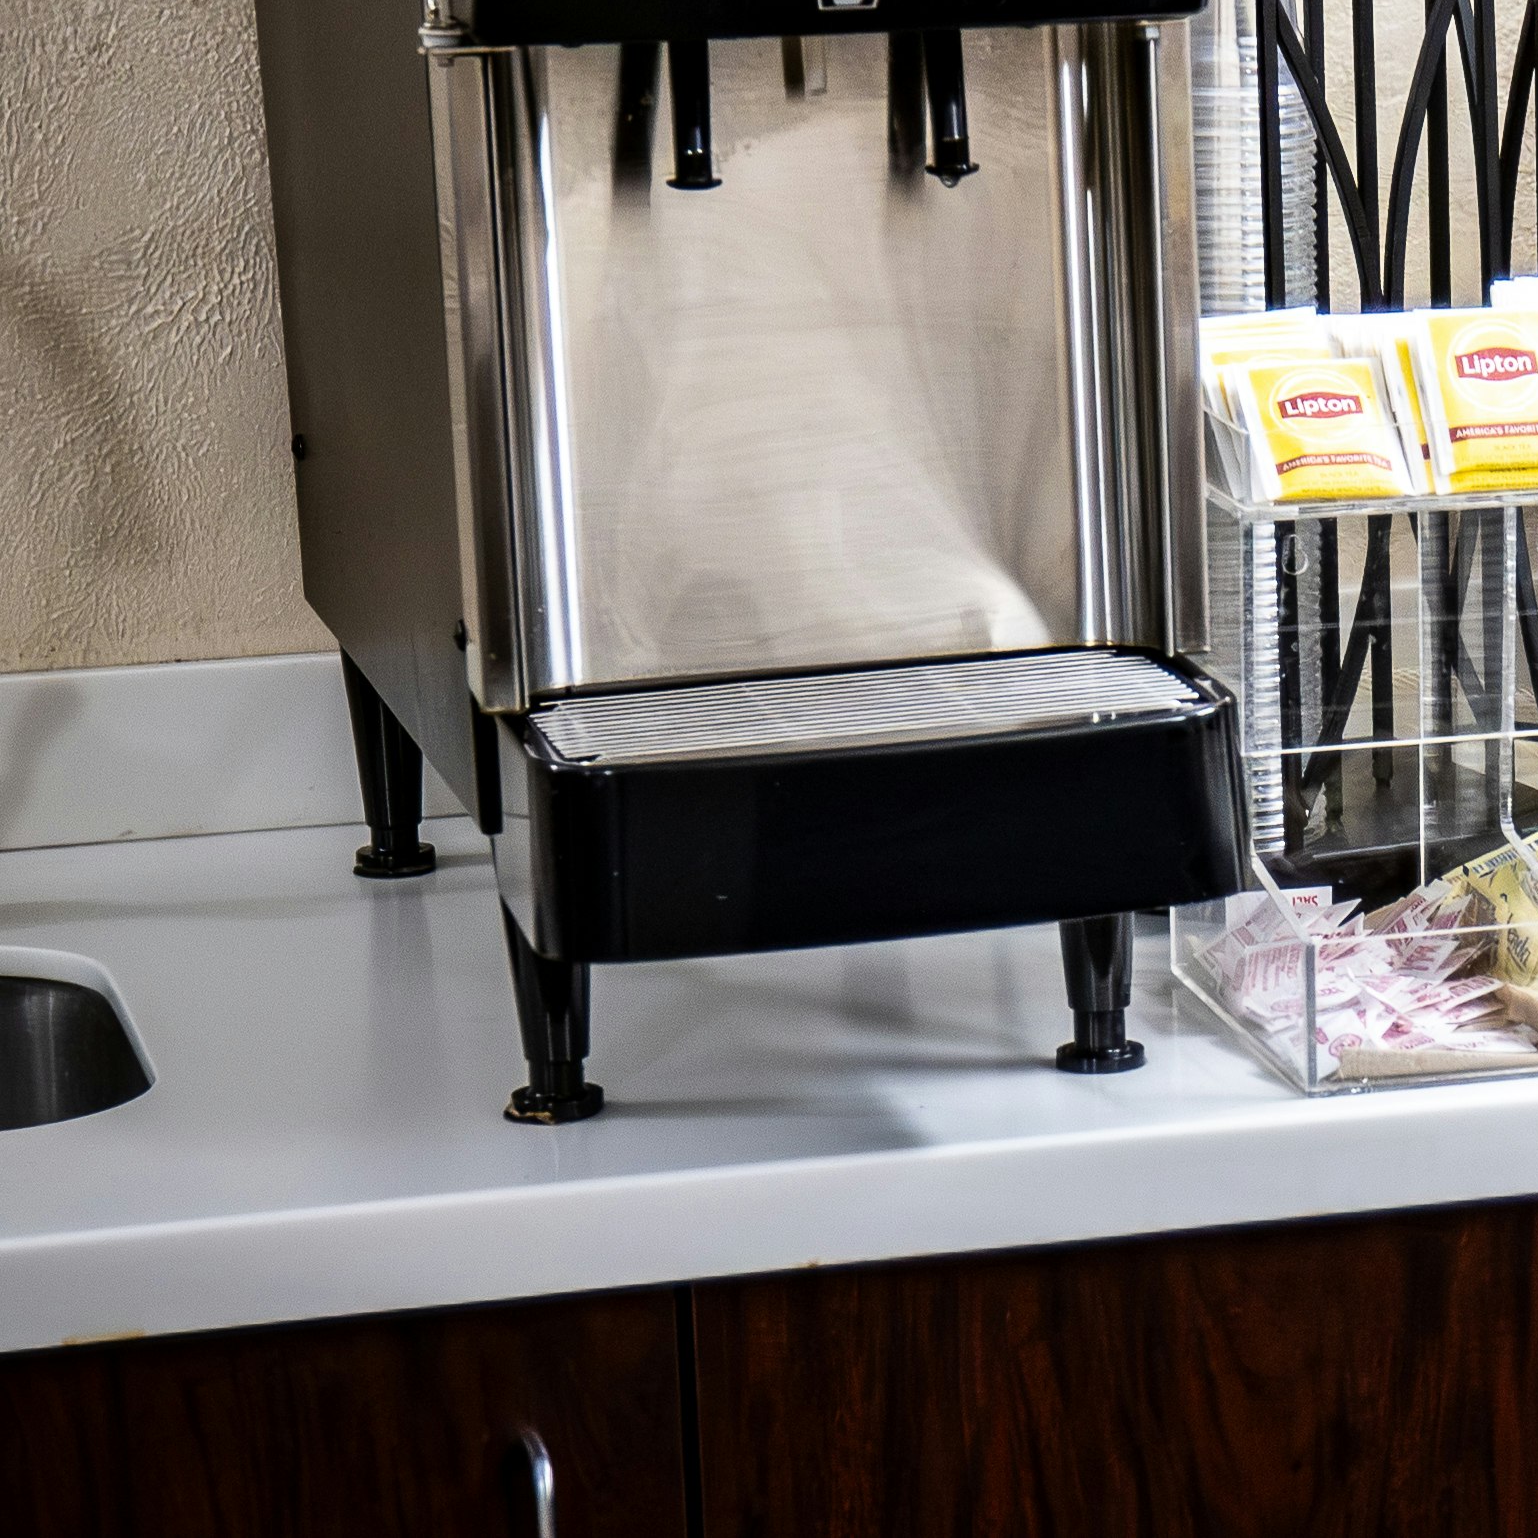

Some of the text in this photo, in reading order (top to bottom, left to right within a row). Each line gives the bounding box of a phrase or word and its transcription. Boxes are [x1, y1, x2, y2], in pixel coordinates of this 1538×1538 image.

[1461, 354, 1533, 377] Lipton
[1284, 397, 1357, 416] Lipton
[1455, 426, 1504, 439] AMERICA'S
[1282, 455, 1330, 472] AMERICA'S
[1330, 453, 1372, 465] FAVORITE
